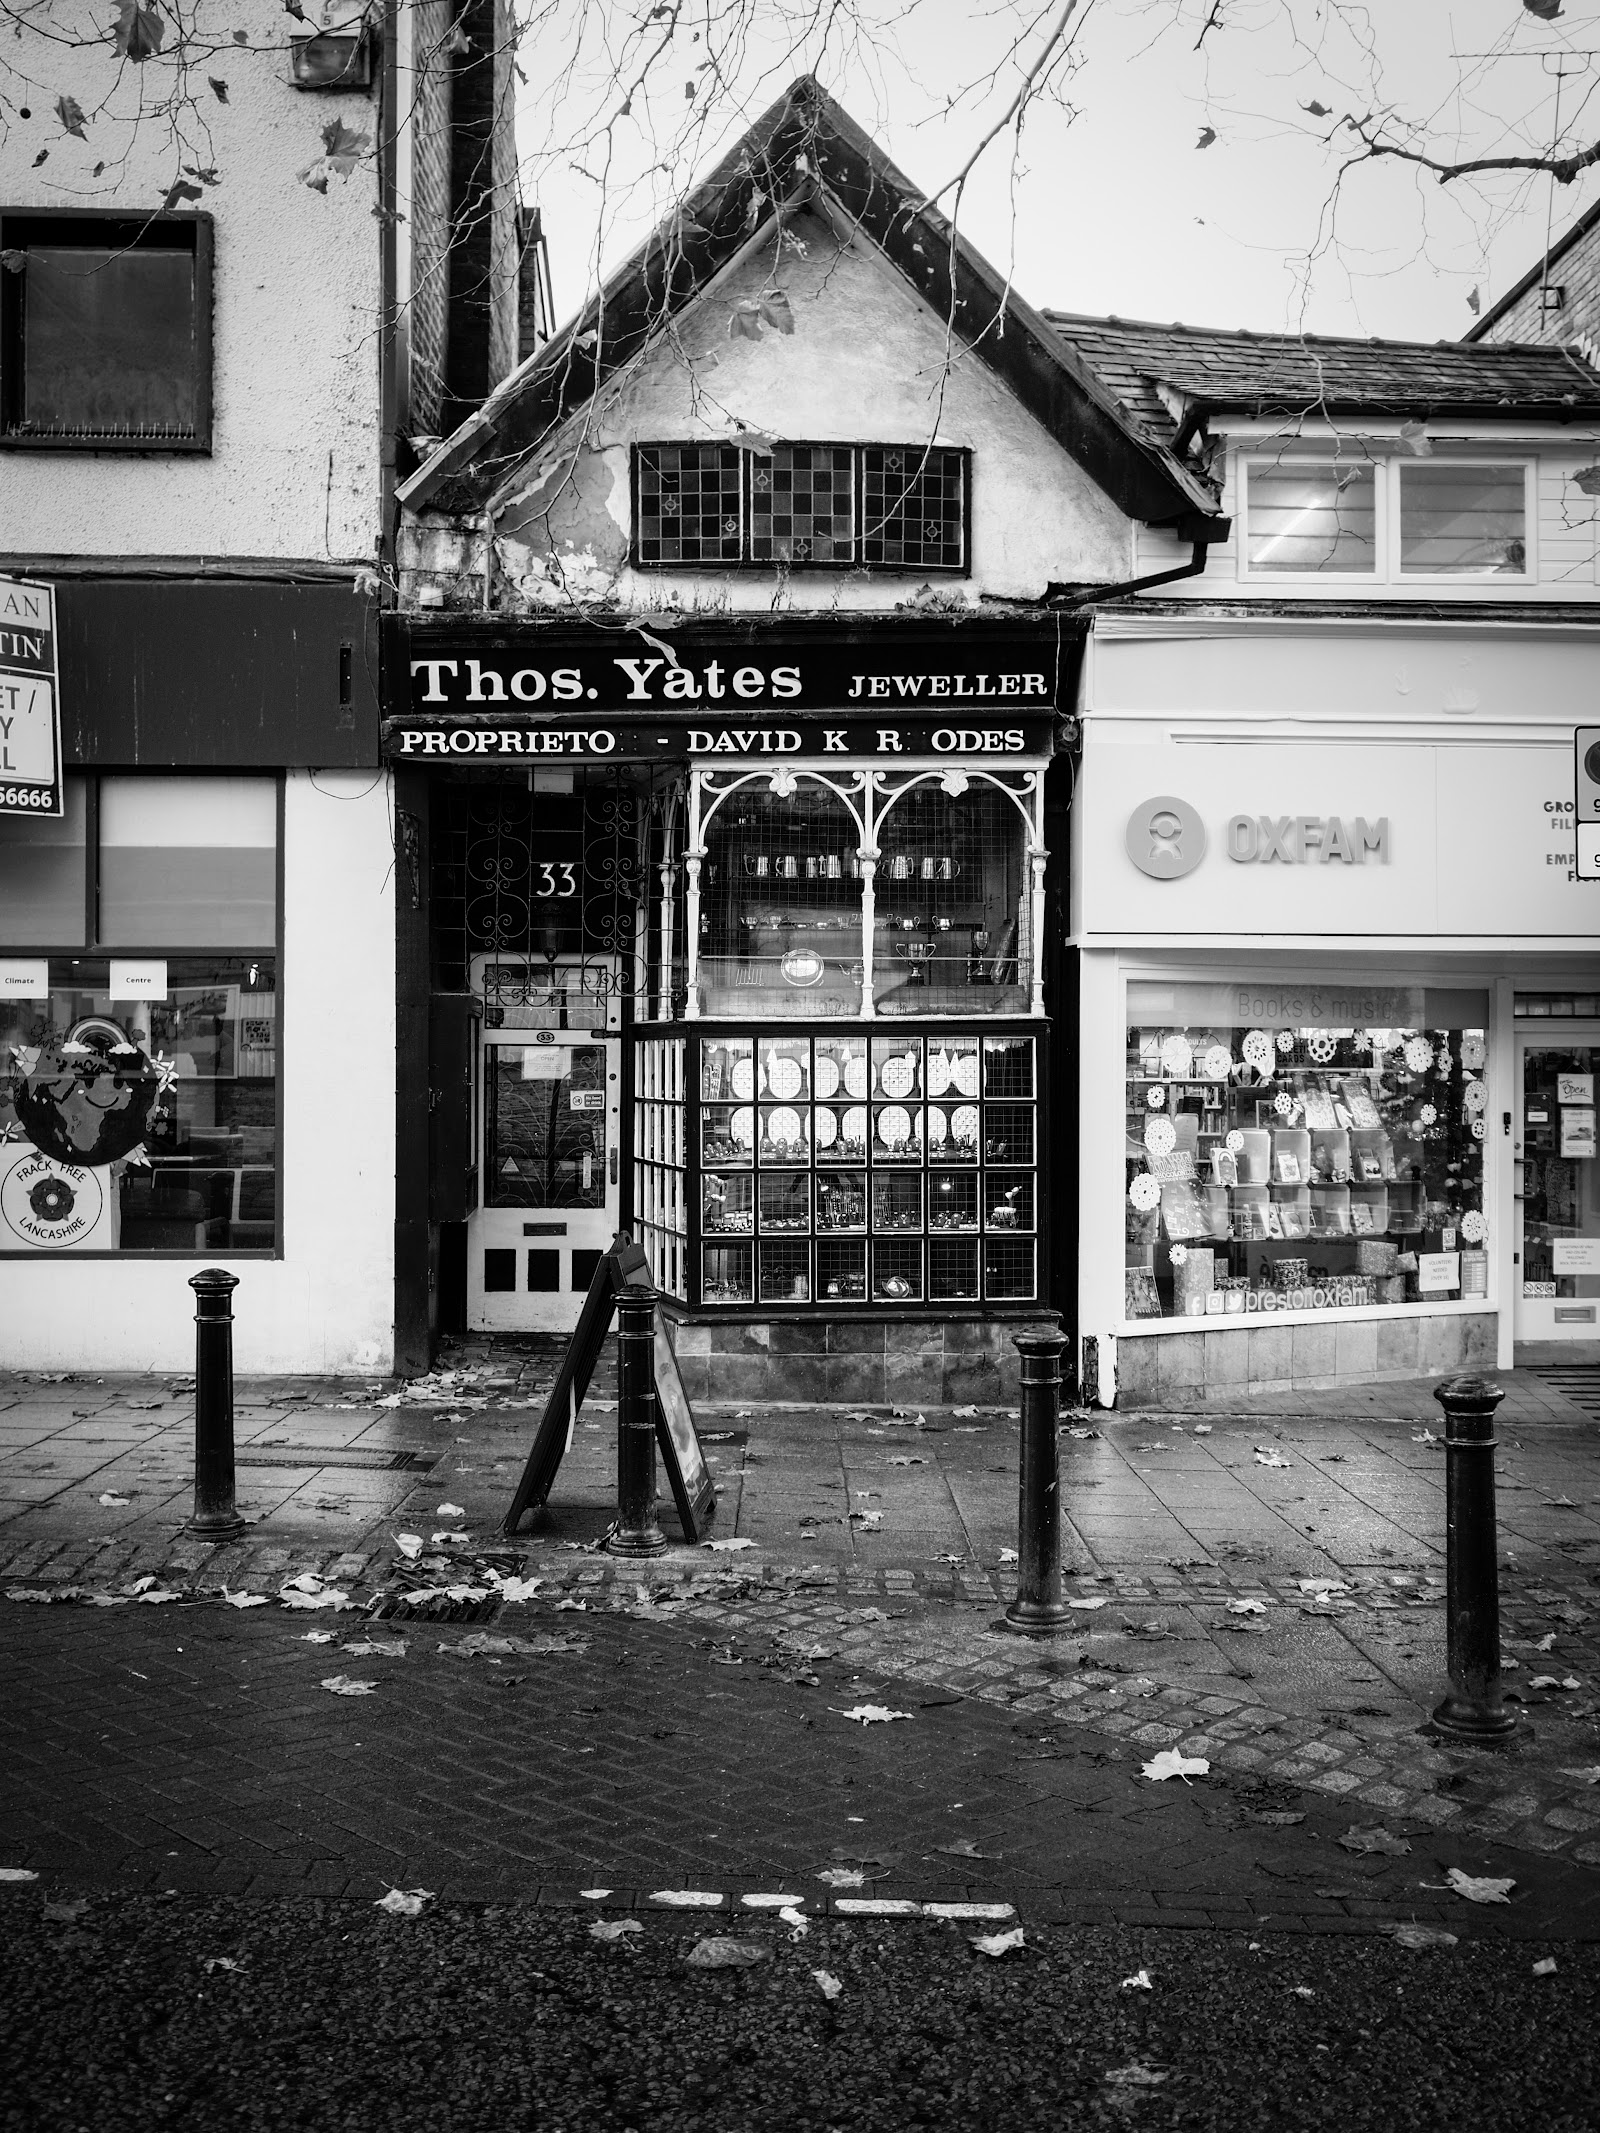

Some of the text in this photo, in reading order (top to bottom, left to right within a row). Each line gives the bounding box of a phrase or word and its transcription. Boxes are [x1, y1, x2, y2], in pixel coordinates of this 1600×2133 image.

[323, 15, 332, 26] 5
[410, 656, 1048, 702] Thos. Yates JEWELLER
[400, 729, 616, 754] PROPRIETO
[686, 730, 802, 752] DAVID
[822, 730, 850, 752] K
[1227, 814, 1391, 864] OXFAM
[535, 862, 576, 898] 33
[4, 977, 35, 985] Climate
[1238, 993, 1393, 1020] Books & music
[16, 1160, 87, 1183] FRACK FREE
[19, 1216, 86, 1239] LANCASHIRE
